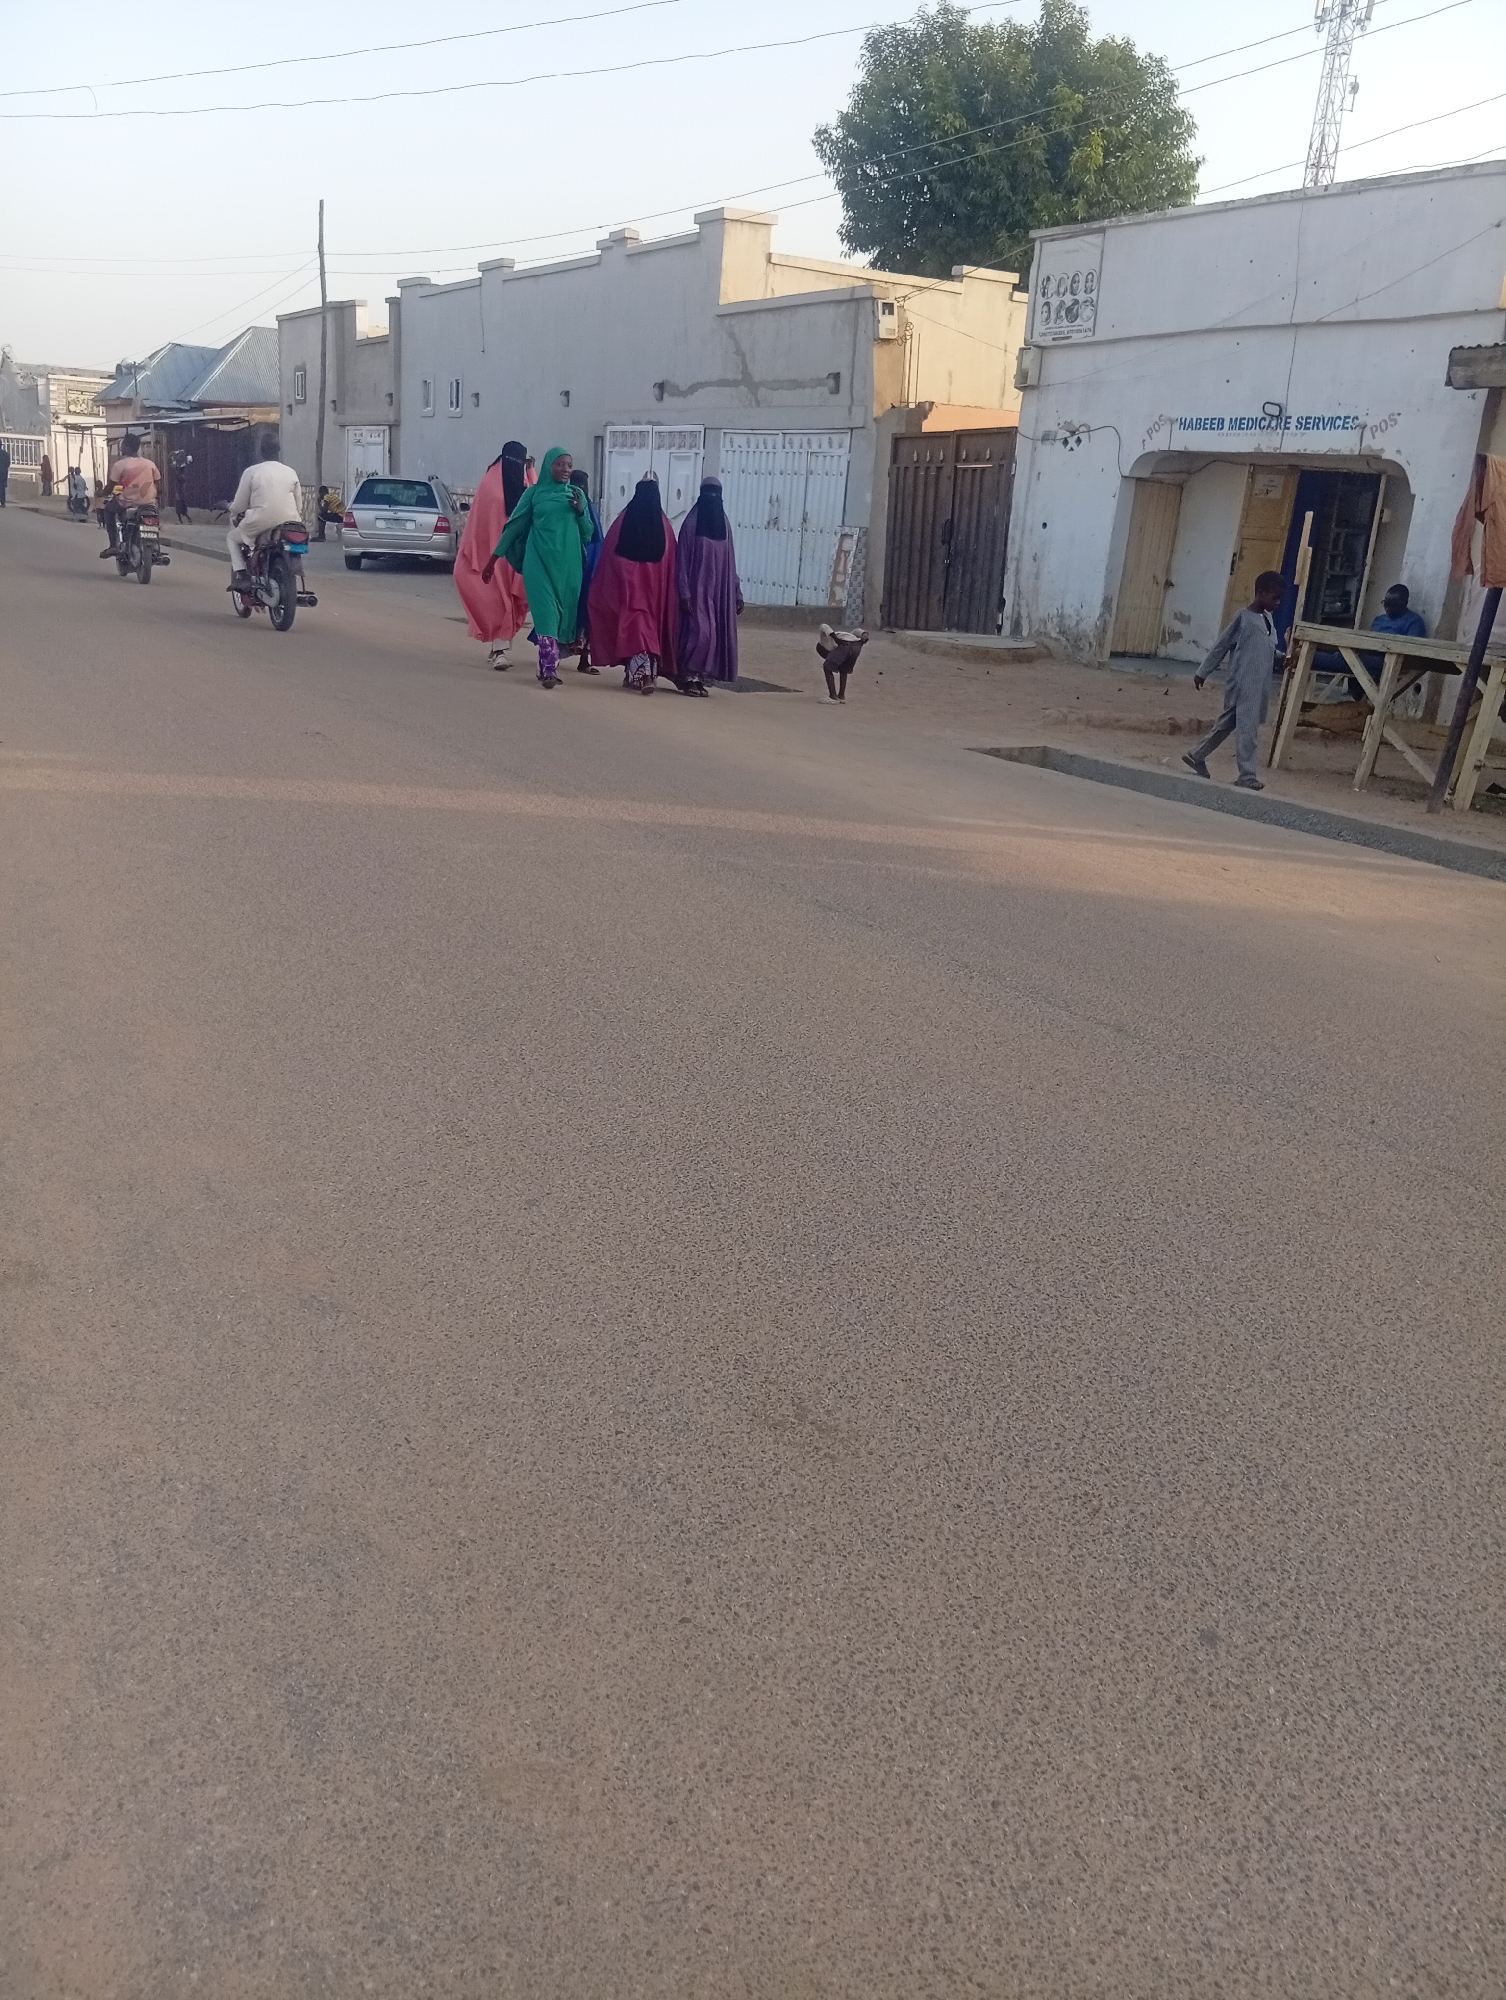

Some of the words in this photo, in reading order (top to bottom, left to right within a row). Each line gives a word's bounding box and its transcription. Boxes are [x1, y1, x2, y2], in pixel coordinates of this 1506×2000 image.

[1178, 416, 1225, 431] HABEEB
[1228, 415, 1293, 431] MEDICARE
[1295, 415, 1360, 431] SERVICES
[1370, 412, 1398, 440] POS
